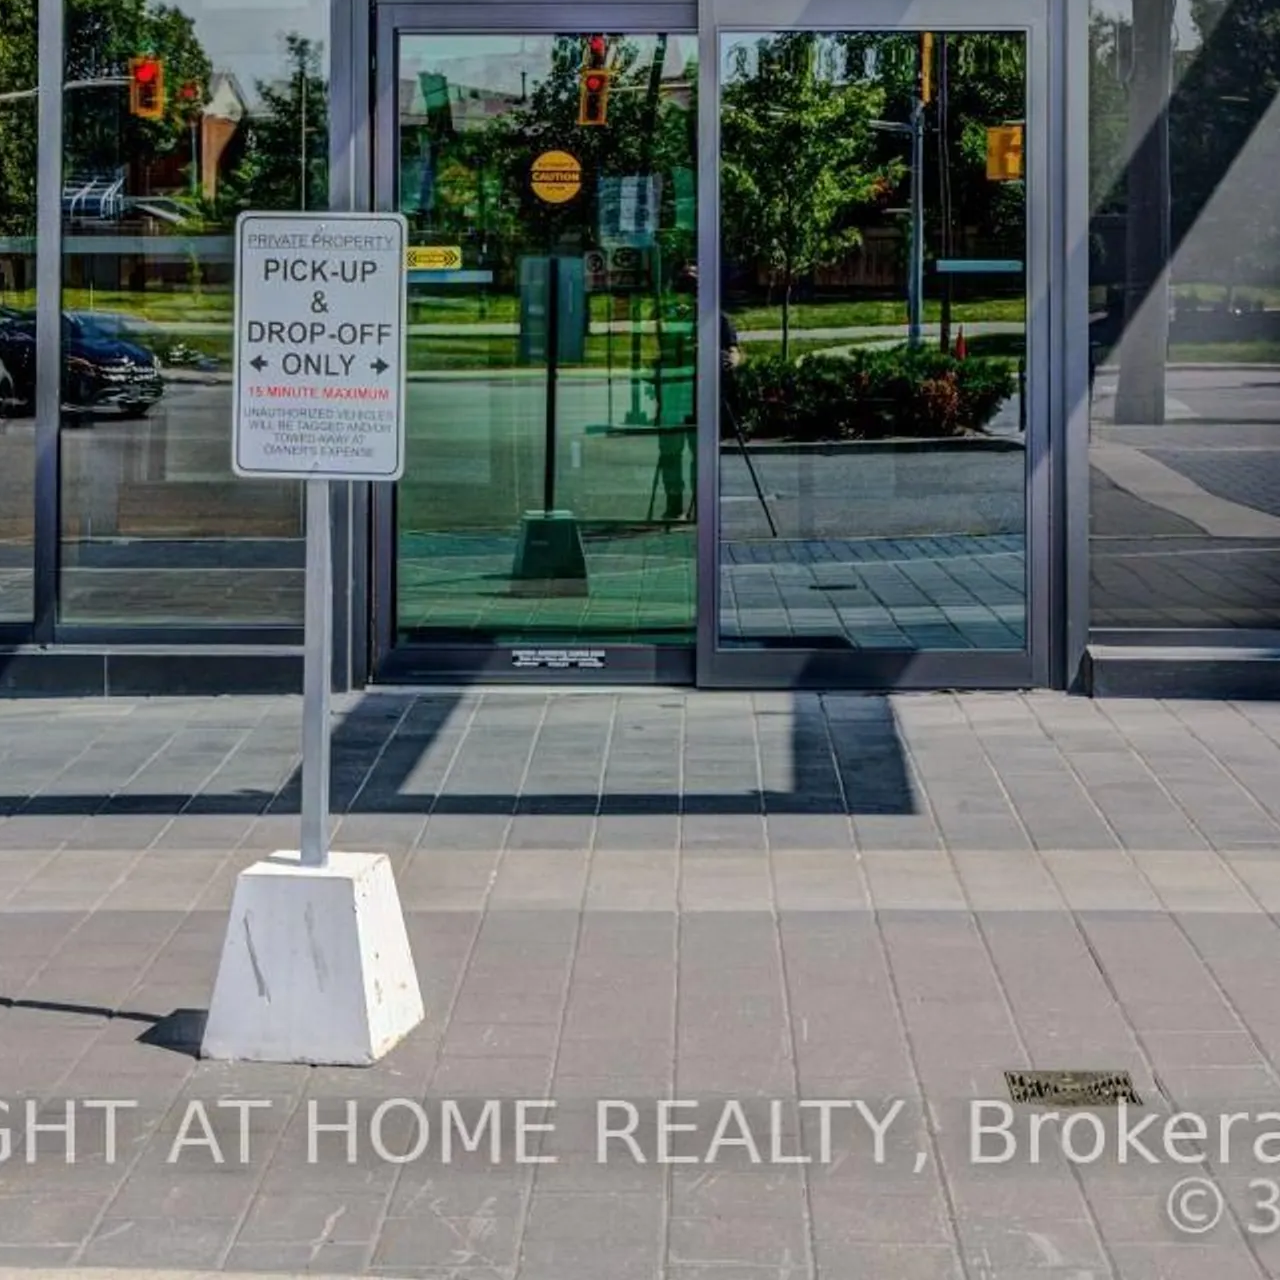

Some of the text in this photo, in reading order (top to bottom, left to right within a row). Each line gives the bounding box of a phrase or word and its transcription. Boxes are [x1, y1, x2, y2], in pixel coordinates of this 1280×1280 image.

[532, 171, 579, 181] CAUTION
[248, 234, 394, 250] PRIVATE PROPERTY
[264, 259, 377, 283] PICK-UP
[311, 291, 329, 313] &
[248, 322, 392, 345] DROP-OFF
[282, 353, 356, 376] ONLY
[249, 386, 389, 400] 15 MINUTE MAXIMUM
[244, 407, 393, 421] UNAUTHORIZED VEHICLES
[249, 420, 272, 430] WILL
[278, 421, 293, 431] BE
[297, 421, 346, 432] TAGGED
